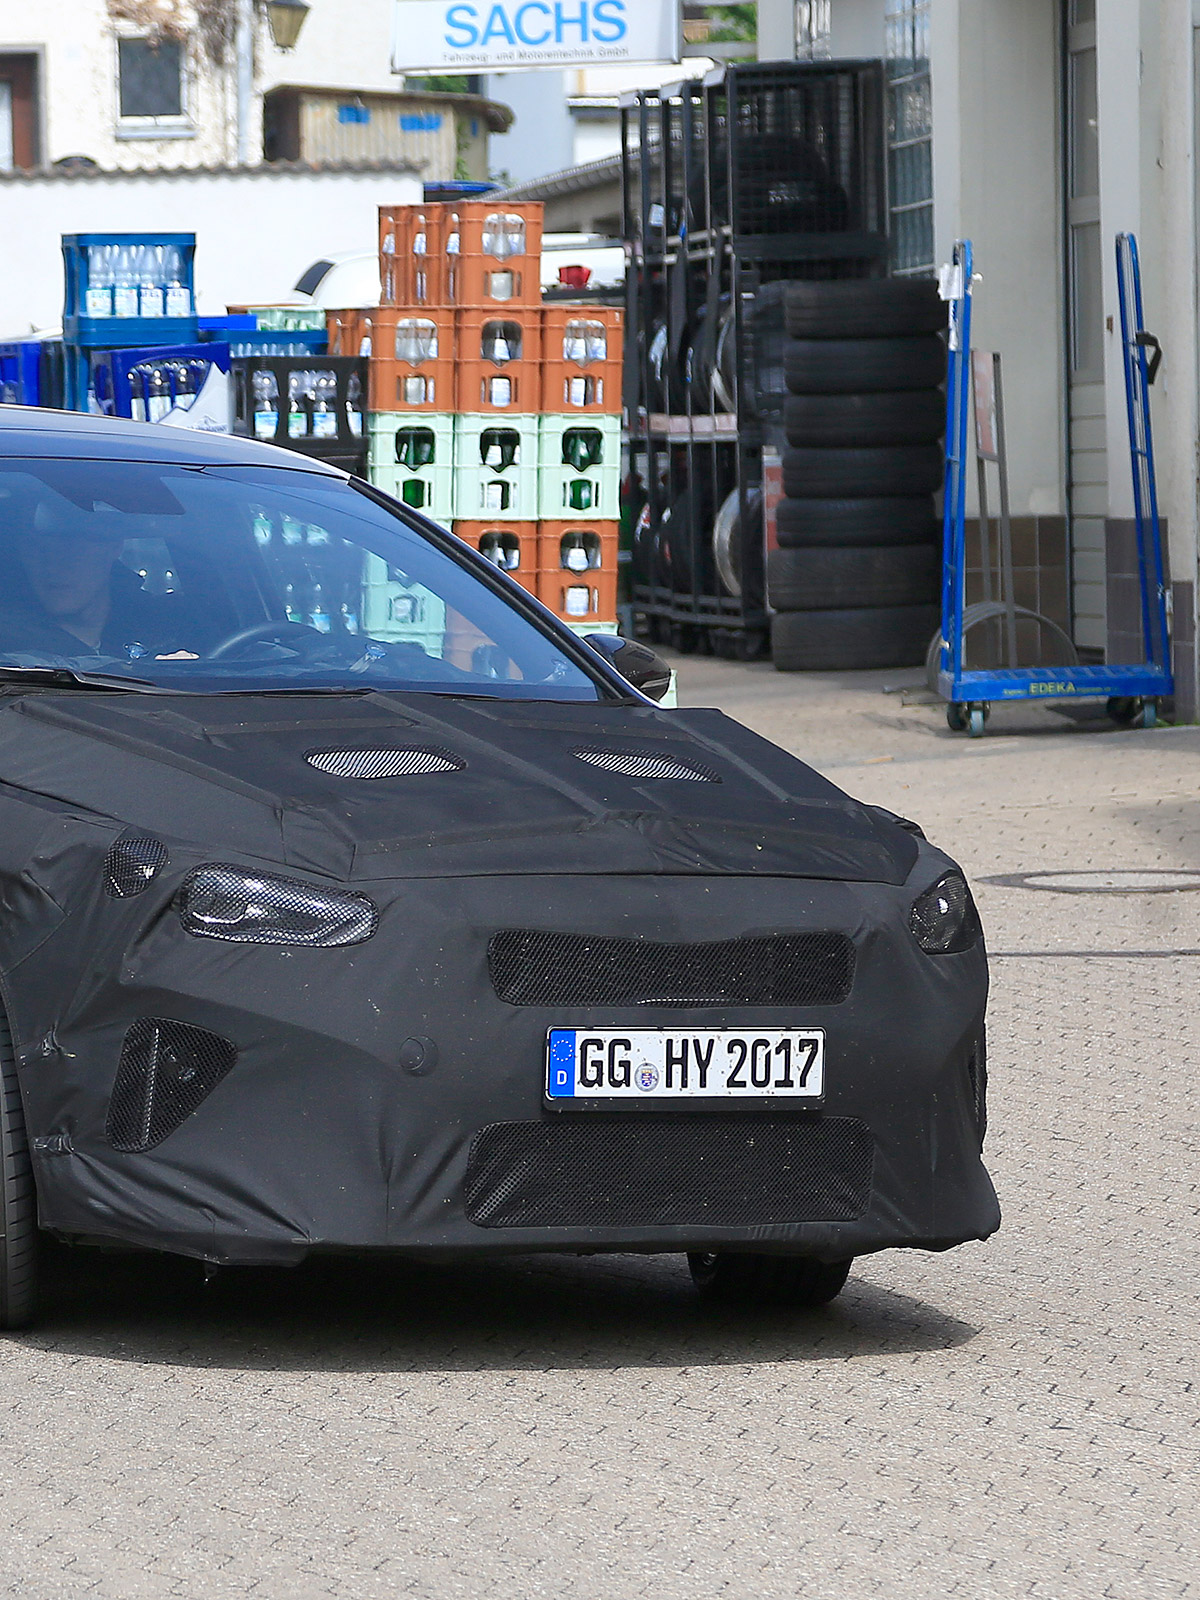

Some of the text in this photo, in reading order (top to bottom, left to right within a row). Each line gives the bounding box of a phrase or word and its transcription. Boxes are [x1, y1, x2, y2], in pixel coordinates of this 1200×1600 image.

[445, 0, 627, 48] SACHS
[599, 45, 630, 57] GmbH
[1029, 681, 1076, 696] EDEKA
[580, 1038, 819, 1088] GG HY 2017
[556, 1070, 567, 1086] D
